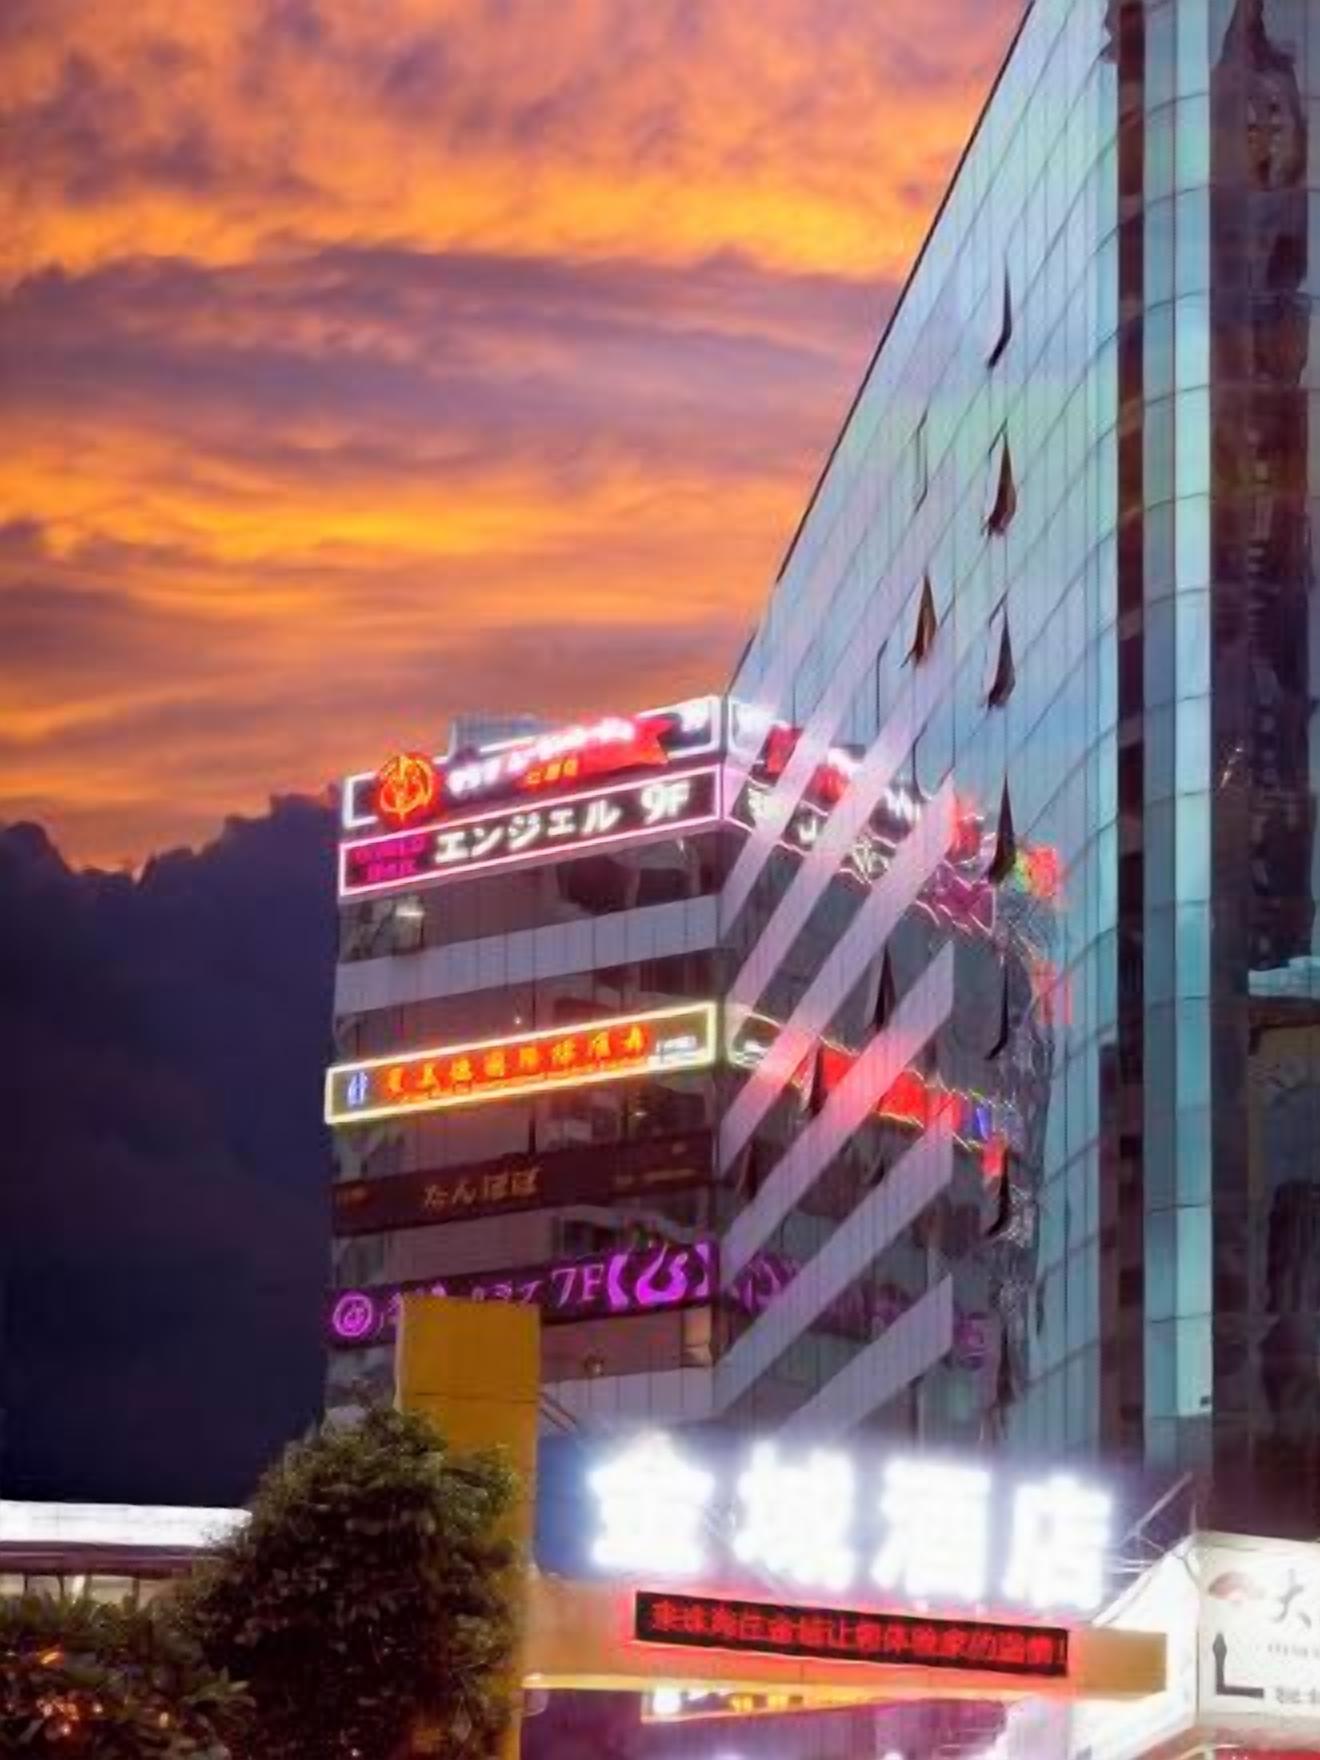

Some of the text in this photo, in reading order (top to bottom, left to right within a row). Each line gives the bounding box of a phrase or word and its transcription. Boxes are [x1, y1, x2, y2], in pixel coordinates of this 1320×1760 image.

[434, 800, 622, 864] エンジェル
